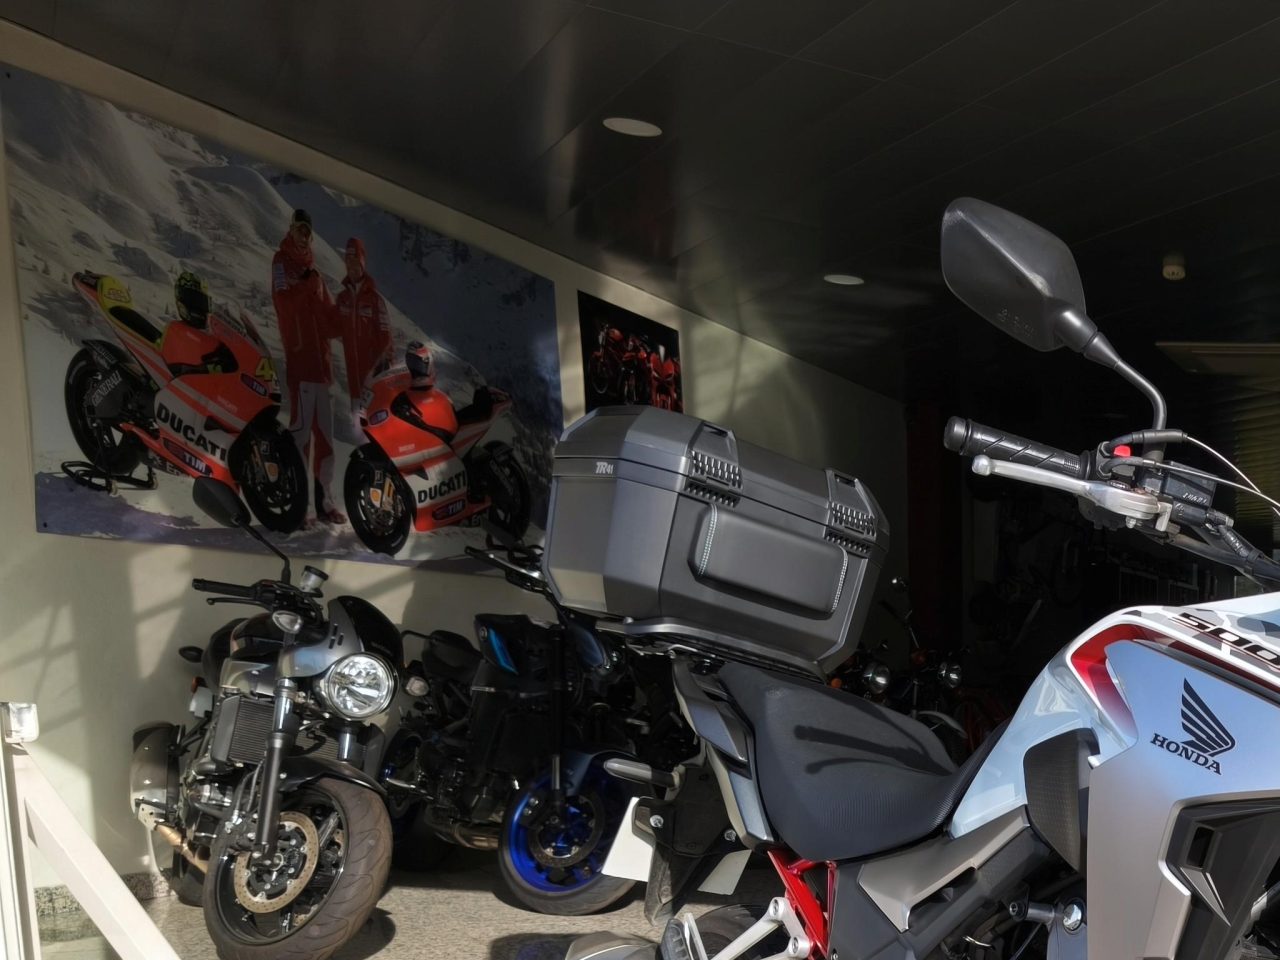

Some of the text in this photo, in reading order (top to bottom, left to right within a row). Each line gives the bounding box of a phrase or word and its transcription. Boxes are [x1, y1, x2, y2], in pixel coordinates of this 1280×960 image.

[156, 402, 228, 461] DUCATI
[184, 452, 206, 473] TIM
[418, 470, 467, 504] DUCATI
[448, 500, 463, 513] TIM
[1150, 732, 1222, 776] HONDA
